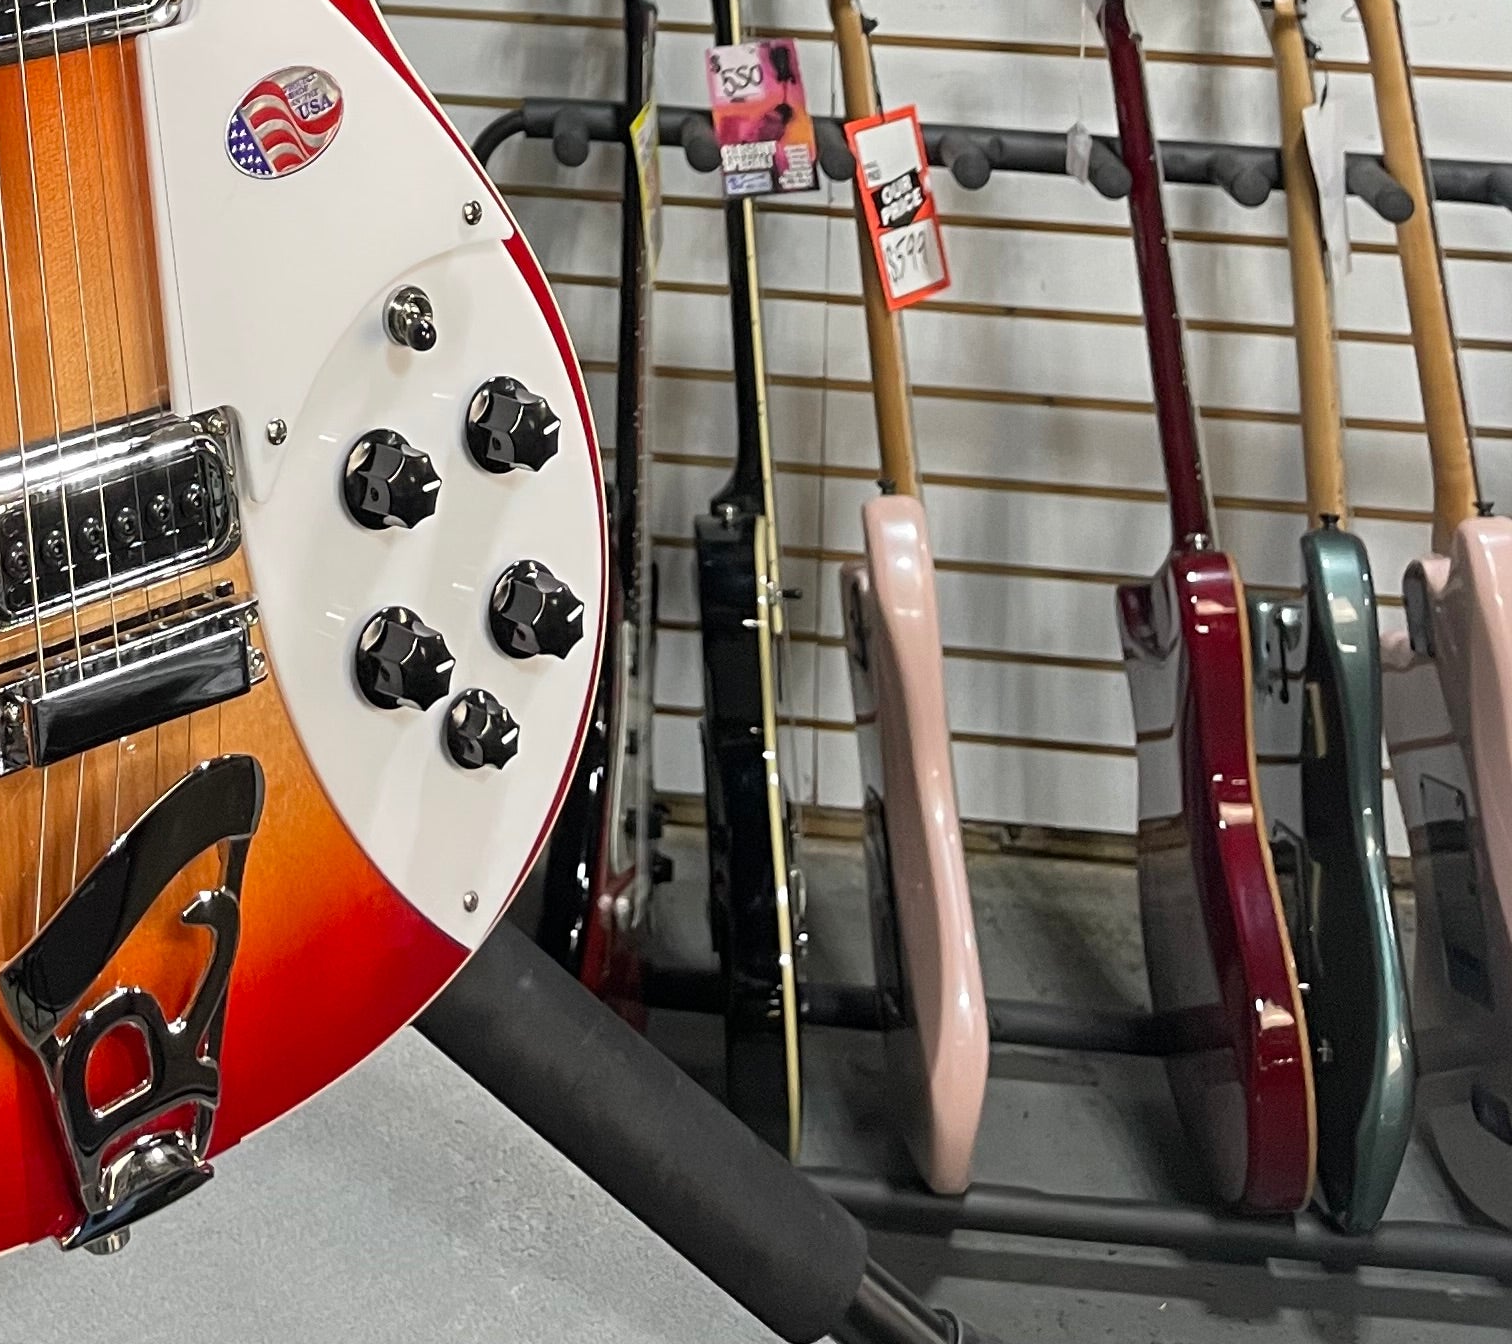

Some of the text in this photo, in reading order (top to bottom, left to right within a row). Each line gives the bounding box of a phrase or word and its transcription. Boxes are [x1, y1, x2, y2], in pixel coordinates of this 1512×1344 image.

[296, 93, 335, 120] USA
[880, 174, 914, 205] OUR
[880, 186, 925, 227] PRICE
